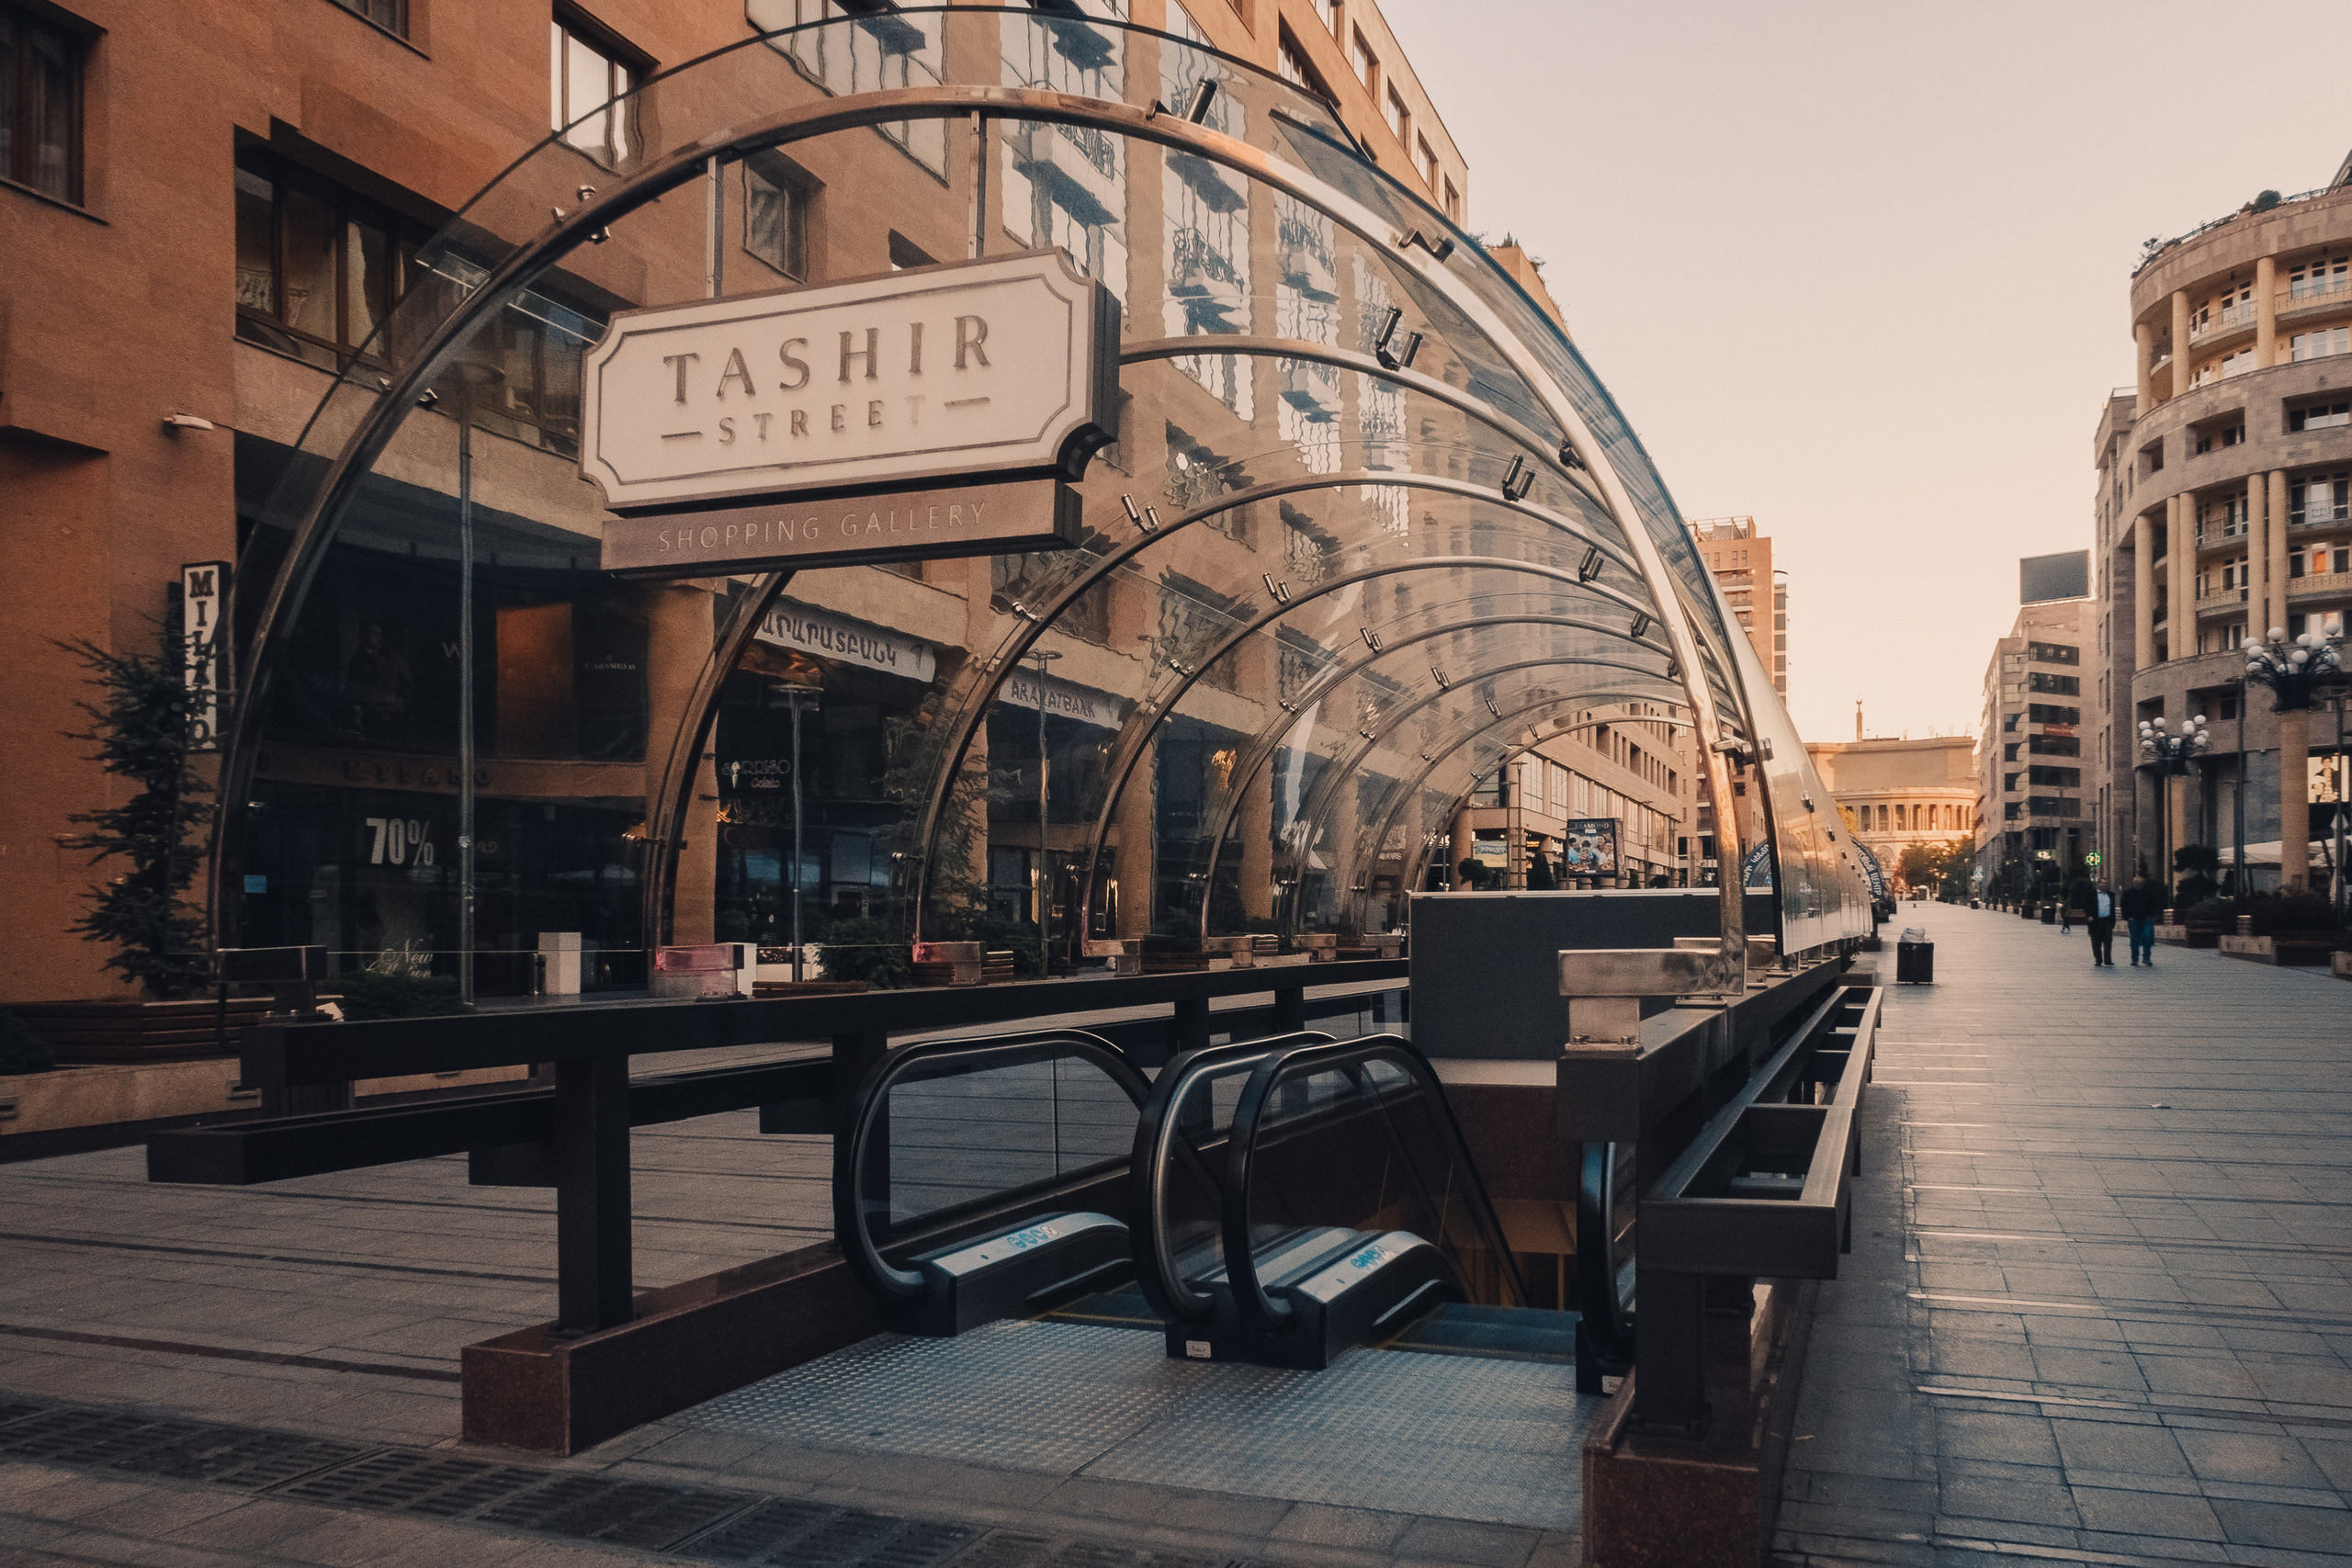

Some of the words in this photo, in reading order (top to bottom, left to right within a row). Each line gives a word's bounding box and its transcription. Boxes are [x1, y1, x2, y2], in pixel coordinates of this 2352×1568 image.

[662, 315, 990, 404] TASHIR
[718, 394, 925, 445] STREET
[658, 516, 820, 552] SHOPPING
[841, 502, 986, 536] GALLERY
[1011, 680, 1095, 717] ARAATBANK
[366, 817, 435, 866] 70%
[362, 960, 431, 977] Clltion
